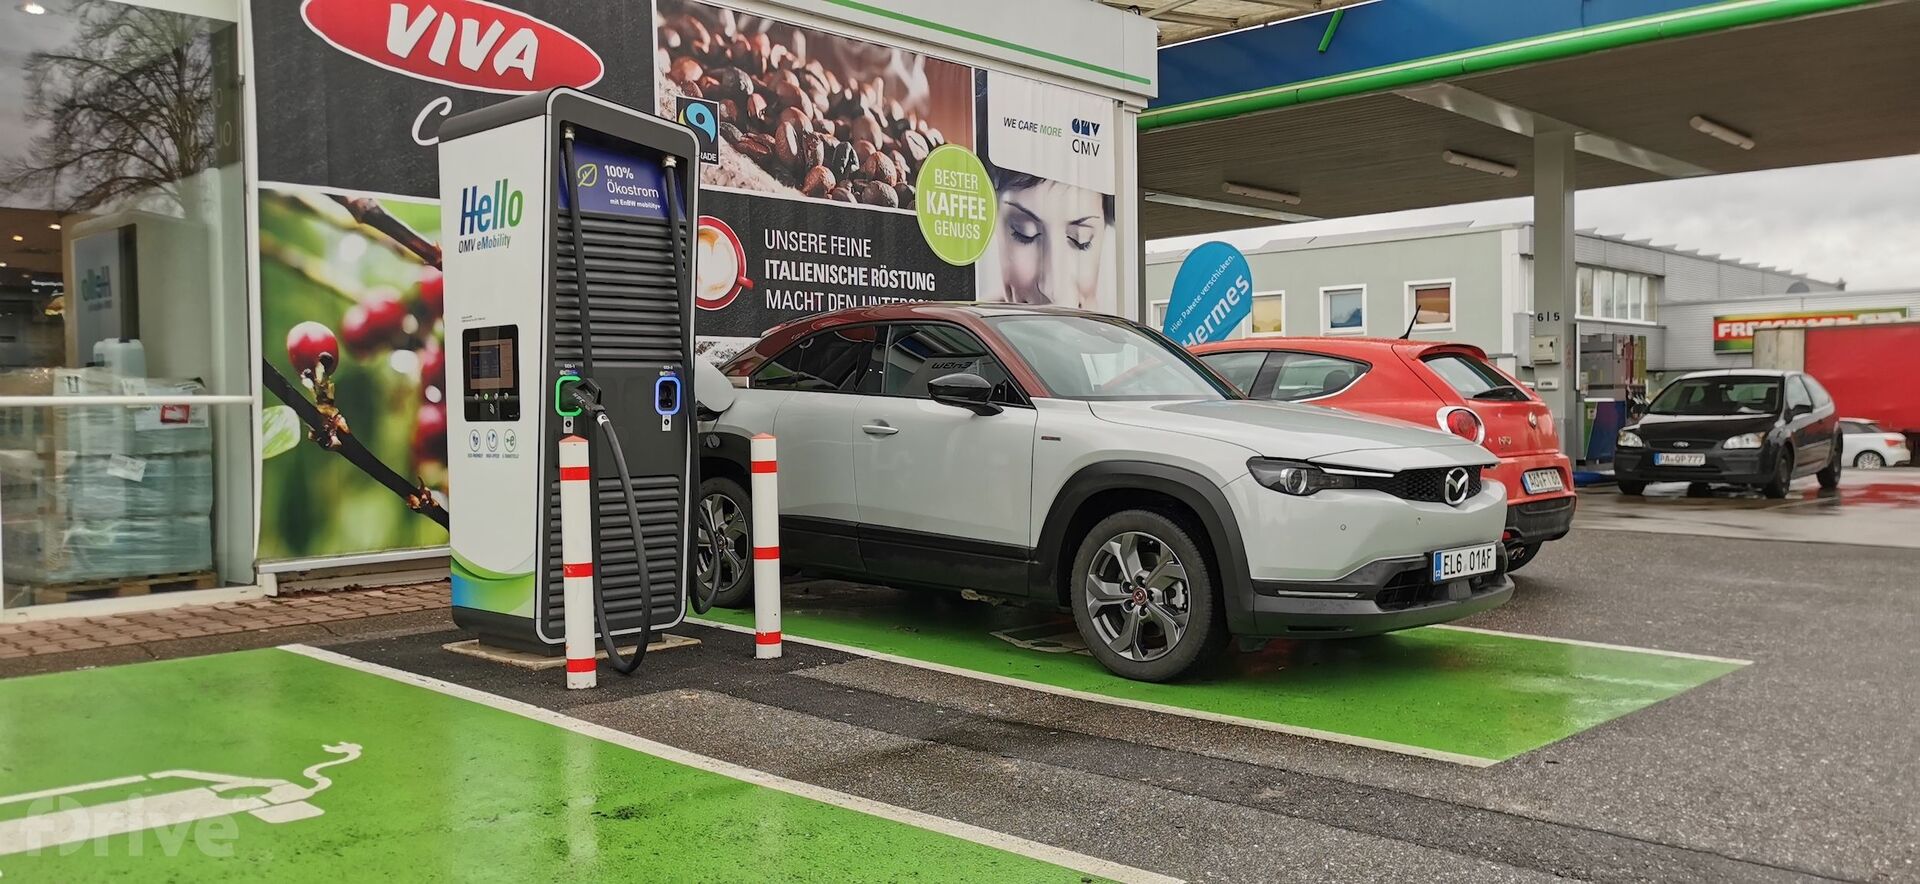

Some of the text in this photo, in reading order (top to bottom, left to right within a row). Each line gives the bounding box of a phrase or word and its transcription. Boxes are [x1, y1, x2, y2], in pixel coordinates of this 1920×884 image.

[387, 3, 539, 81] VIVA
[1003, 116, 1062, 137] WE CARE MORE
[1072, 139, 1100, 157] OMV
[604, 164, 634, 180] 100%
[934, 168, 978, 190] BESTER
[607, 179, 660, 198] Ökostrom
[460, 178, 523, 236] Hello
[926, 189, 987, 221] KAFFEE
[934, 220, 980, 240] GENUSS
[458, 233, 511, 253] OMV eMobility
[764, 228, 872, 258] UNSERE FEINE
[764, 259, 936, 292] ITALIENISCHE RÖSTUNG
[766, 289, 824, 312] MACHT
[1170, 255, 1235, 333] Hier Pakete verschicken.
[1444, 553, 1462, 576] EL6
[1469, 548, 1492, 571] 01AF
